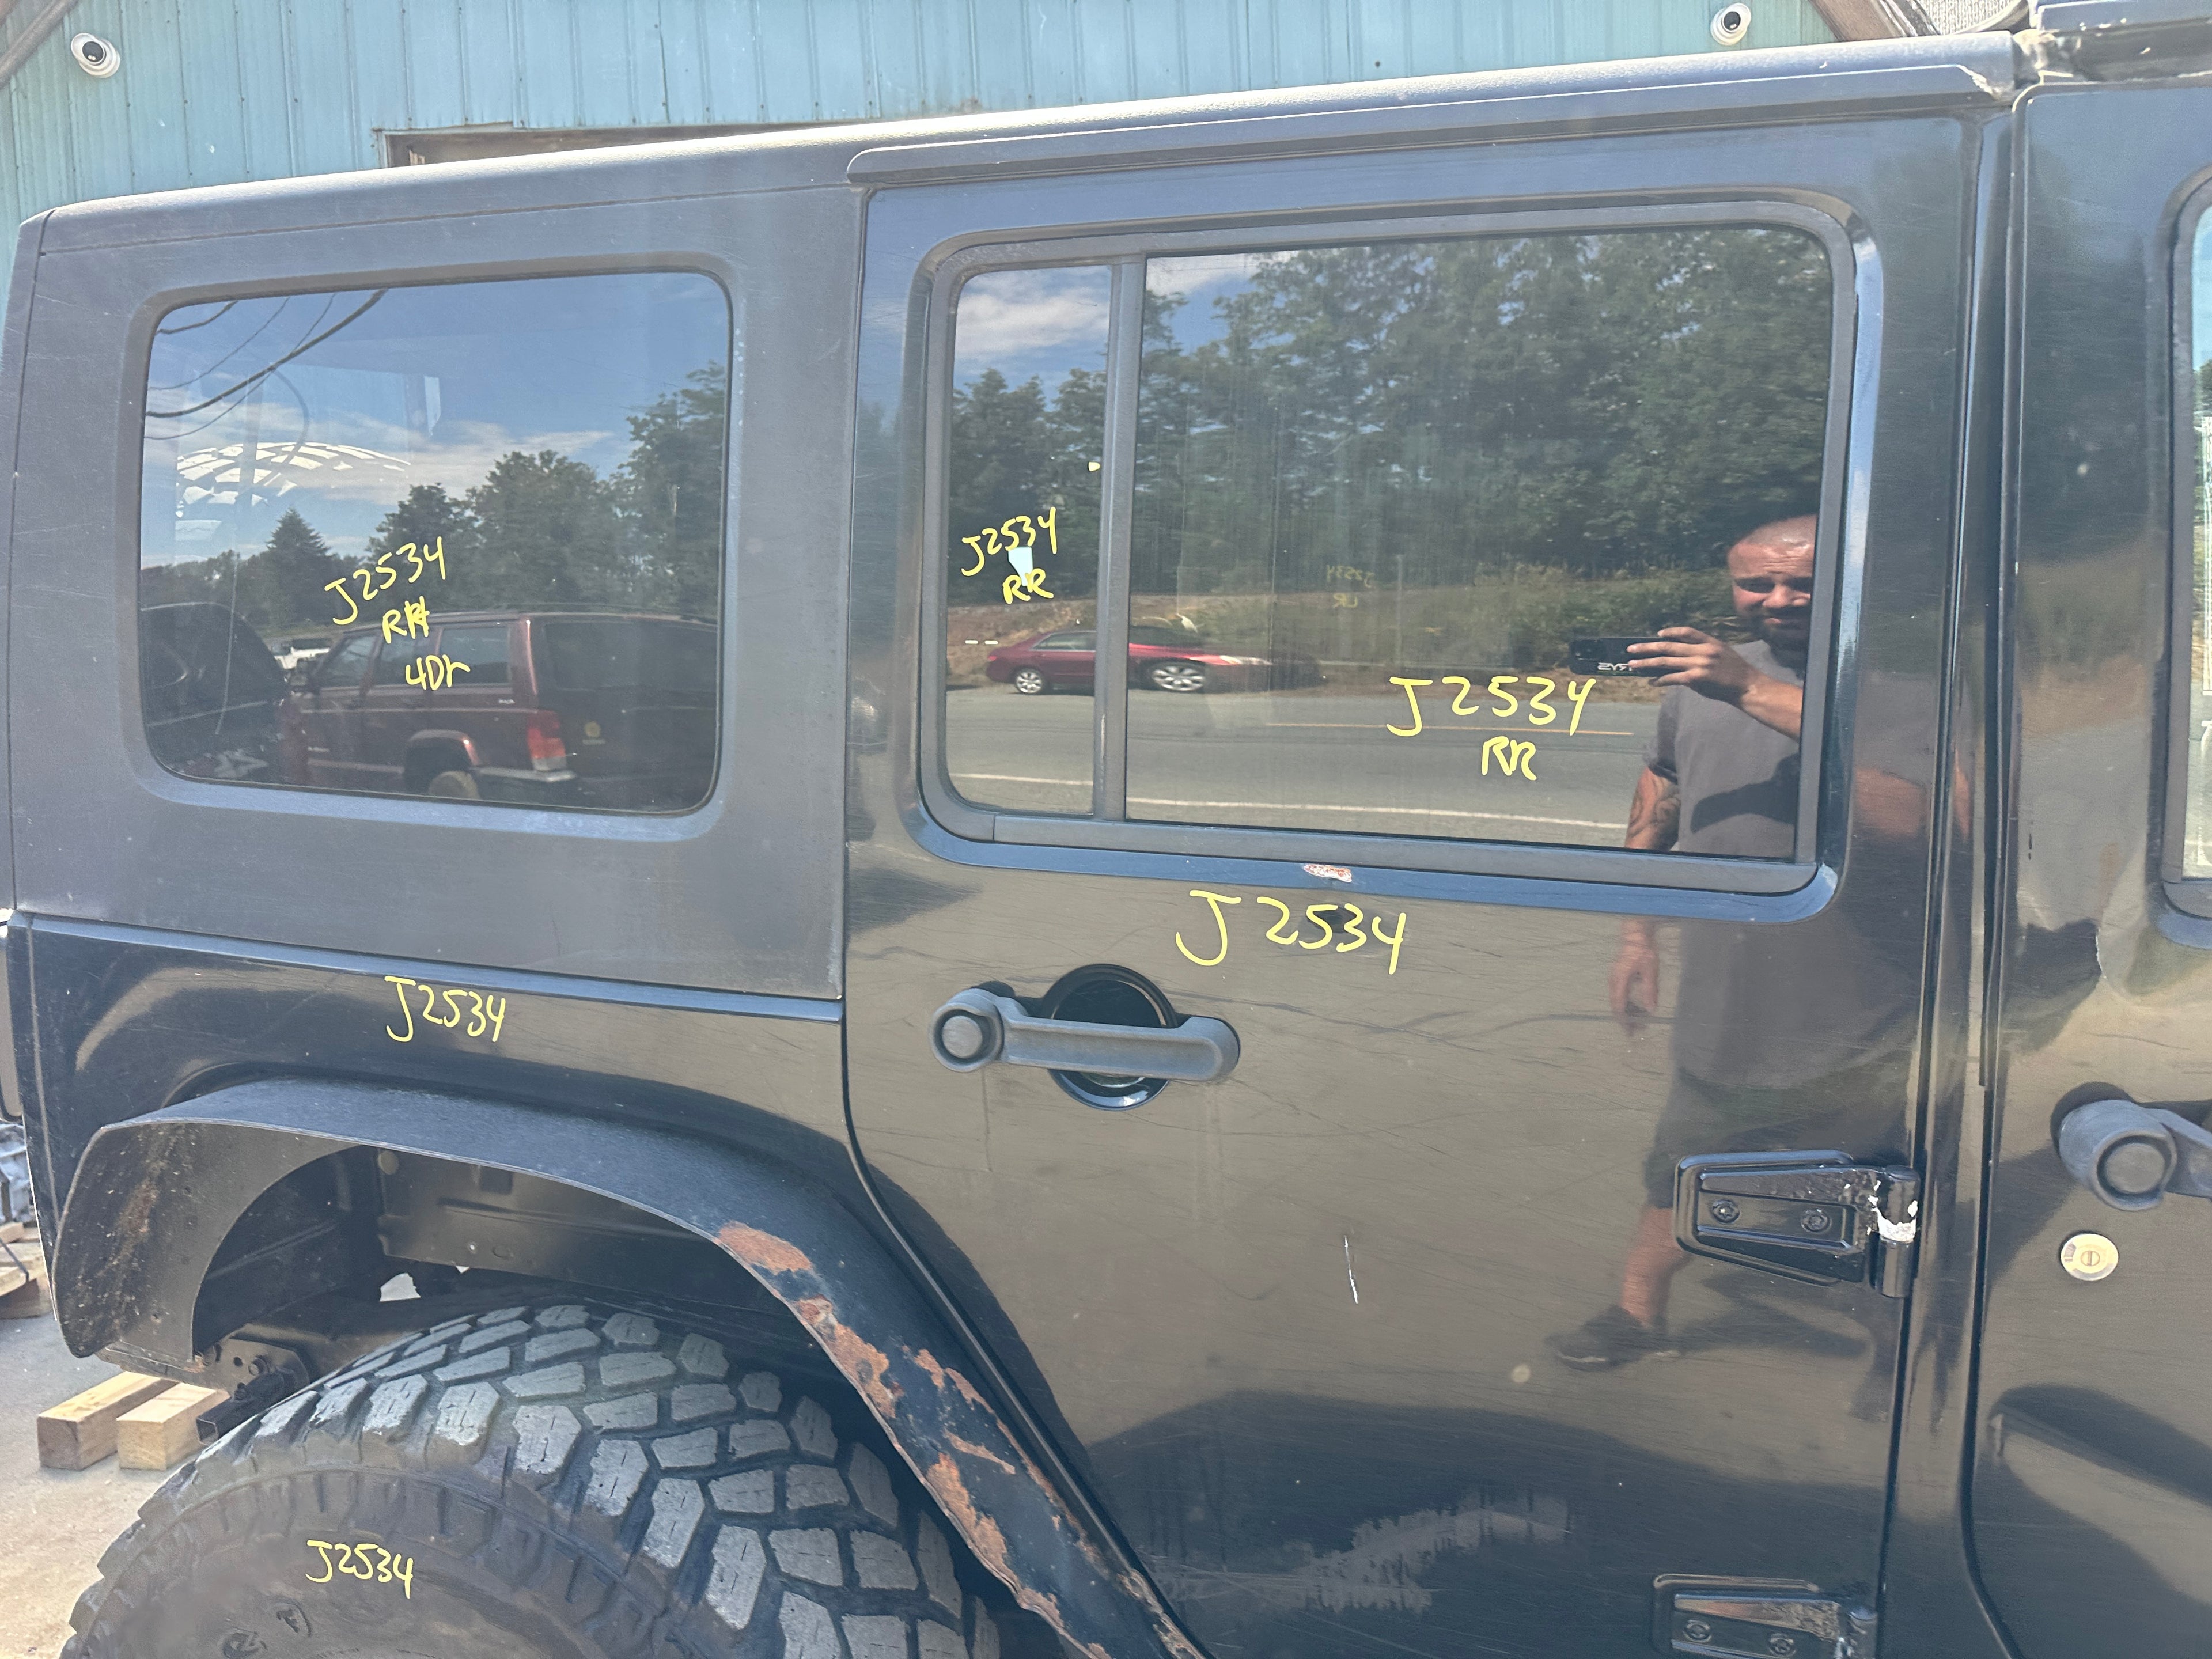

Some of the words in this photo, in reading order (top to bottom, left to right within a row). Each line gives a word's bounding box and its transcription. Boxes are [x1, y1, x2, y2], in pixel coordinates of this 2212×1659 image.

[961, 506, 1057, 576] J2534
[324, 536, 446, 625] J2534
[1002, 568, 1054, 604] RR
[1387, 676, 1596, 737] J2534
[1482, 736, 1537, 781] RR
[1175, 889, 1407, 975] J2534
[384, 975, 506, 1042] J2534
[305, 1539, 414, 1599] J2534
